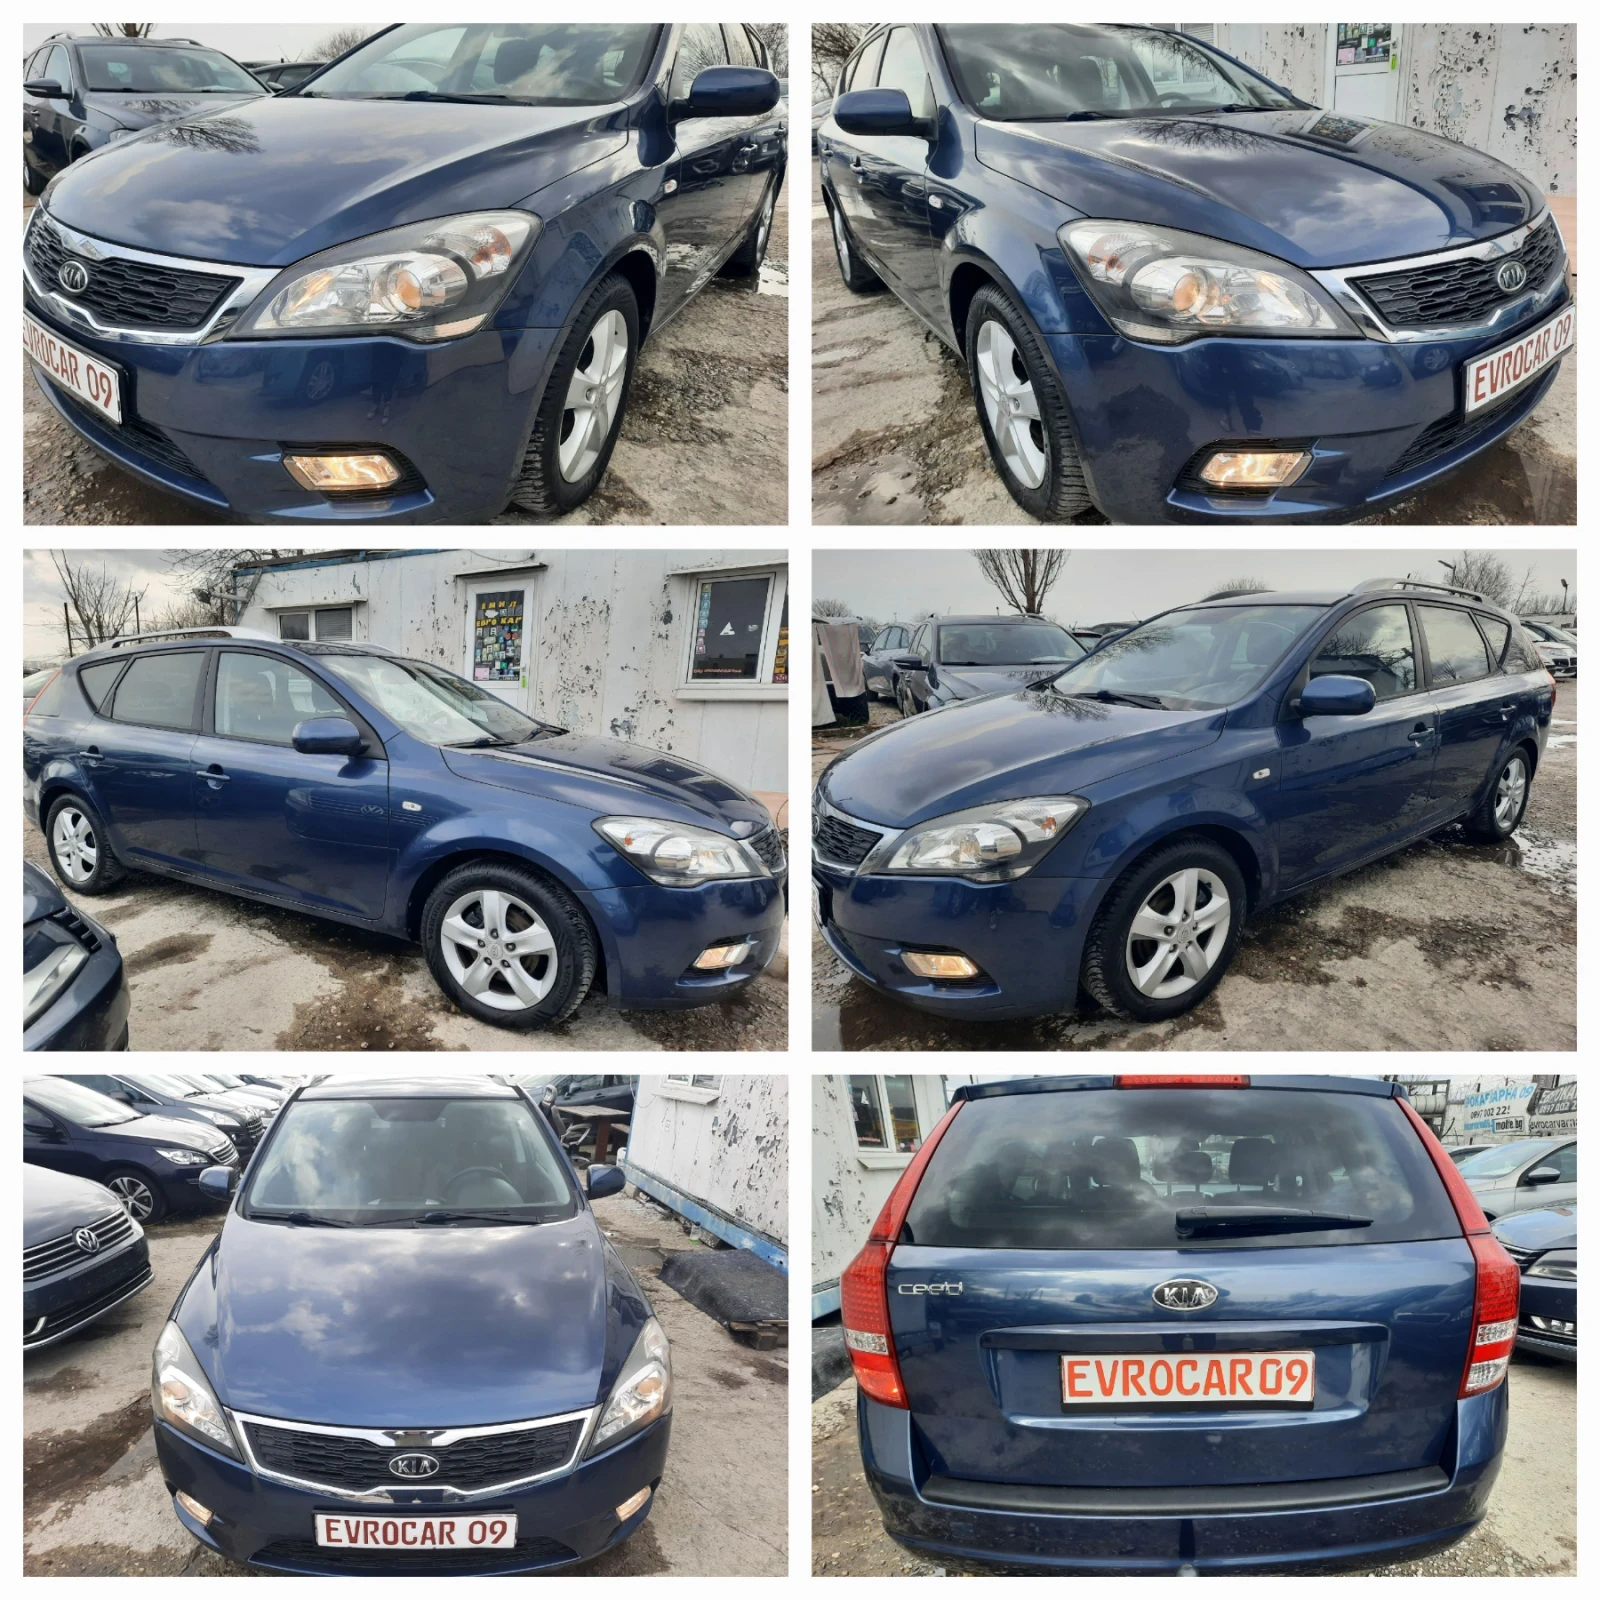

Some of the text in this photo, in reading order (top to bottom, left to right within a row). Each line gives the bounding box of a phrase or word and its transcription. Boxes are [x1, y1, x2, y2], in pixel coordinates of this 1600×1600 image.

[1474, 313, 1572, 404] EVROCAR 09
[86, 362, 112, 409] 09
[1518, 1085, 1535, 1098] 09
[1163, 1286, 1213, 1306] KIA
[325, 1518, 508, 1546] EVROCAR 09
